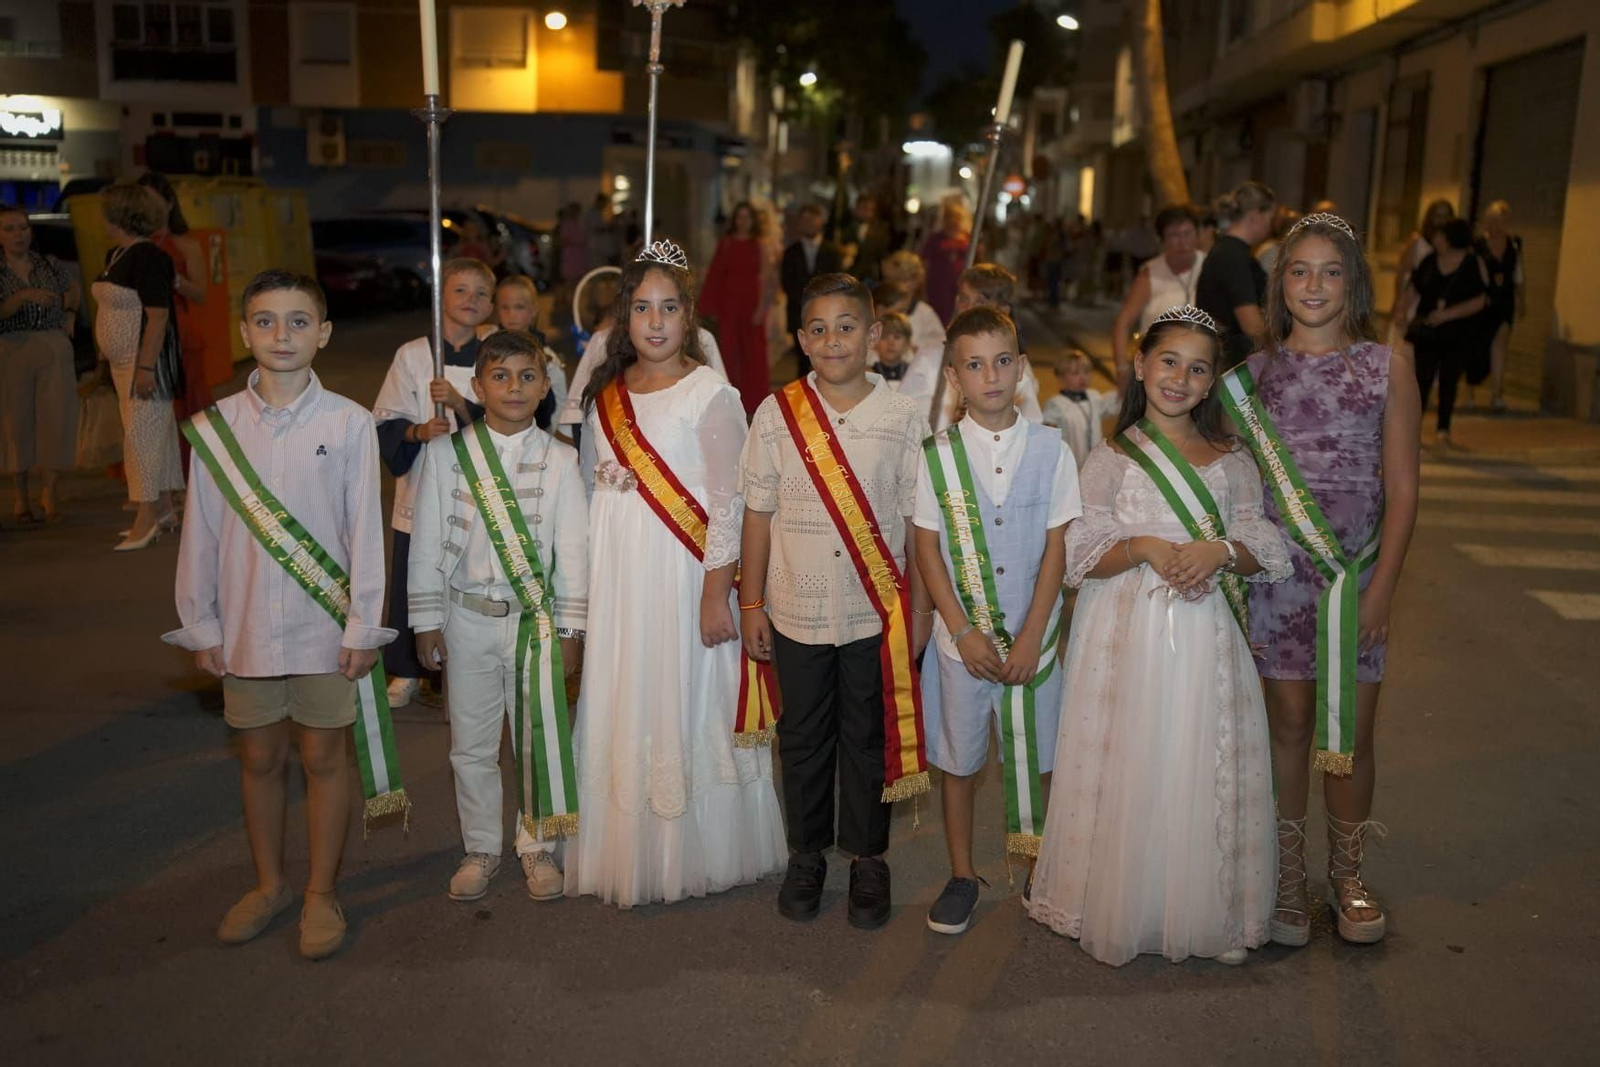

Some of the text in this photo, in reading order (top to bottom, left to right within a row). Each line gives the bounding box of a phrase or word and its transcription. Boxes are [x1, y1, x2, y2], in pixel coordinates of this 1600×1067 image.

[629, 451, 669, 500] Fiestas
[1255, 437, 1288, 487] Fiestas
[475, 476, 516, 531] Caballero
[805, 431, 903, 594] Rey Fiestas Adra 2025
[944, 488, 981, 545] Caballero
[239, 489, 289, 548] Caballero
[278, 540, 328, 588] Fiestas
[495, 532, 531, 578] Fiestas
[954, 552, 986, 595] Fiestas
